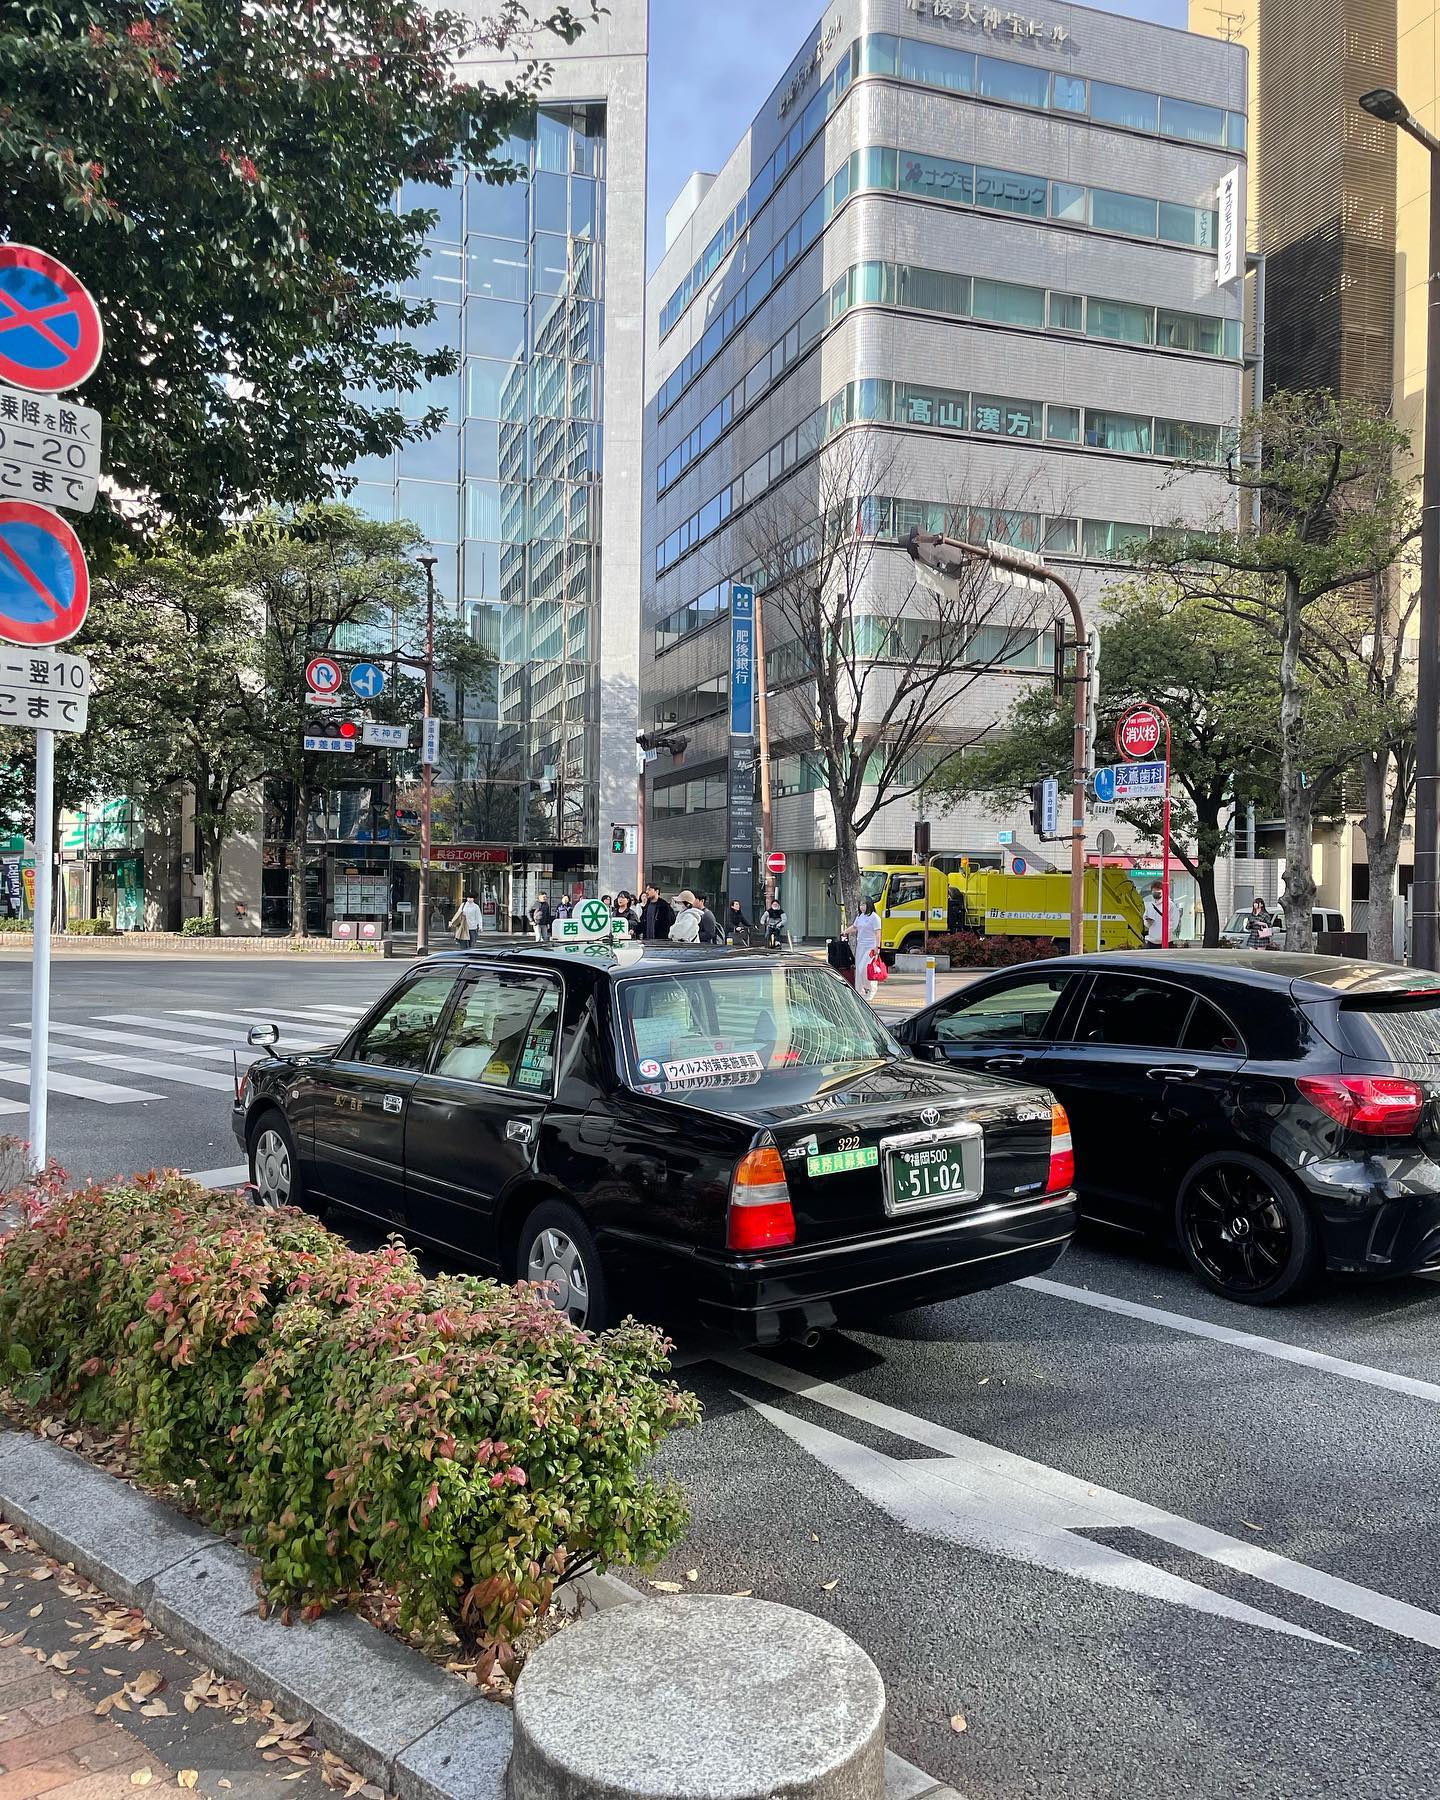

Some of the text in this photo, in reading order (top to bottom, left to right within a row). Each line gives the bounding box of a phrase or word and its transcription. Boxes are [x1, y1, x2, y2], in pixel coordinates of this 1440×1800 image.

[916, 168, 1046, 204] ナグモクリニック
[1224, 193, 1233, 275] ナグモクリニック
[0, 394, 91, 440] 乗降を除く
[1, 462, 84, 502] こまで
[735, 629, 749, 685] 肥後銀行
[370, 727, 401, 740] 天神西
[1126, 725, 1157, 744] 消火栓
[305, 739, 354, 751] 時差信号
[437, 850, 491, 860] 長谷工の仲介
[563, 920, 625, 935] 西 鉄
[642, 1063, 657, 1073] JR
[669, 1054, 759, 1077] ウイルス対策実施車両
[1017, 1111, 1052, 1121] COMFORT
[838, 1136, 860, 1151] 322
[788, 1149, 806, 1158] SG
[808, 1151, 878, 1175] 乗務員募集中
[898, 1179, 909, 1191] い
[909, 1163, 962, 1197] 51-02
